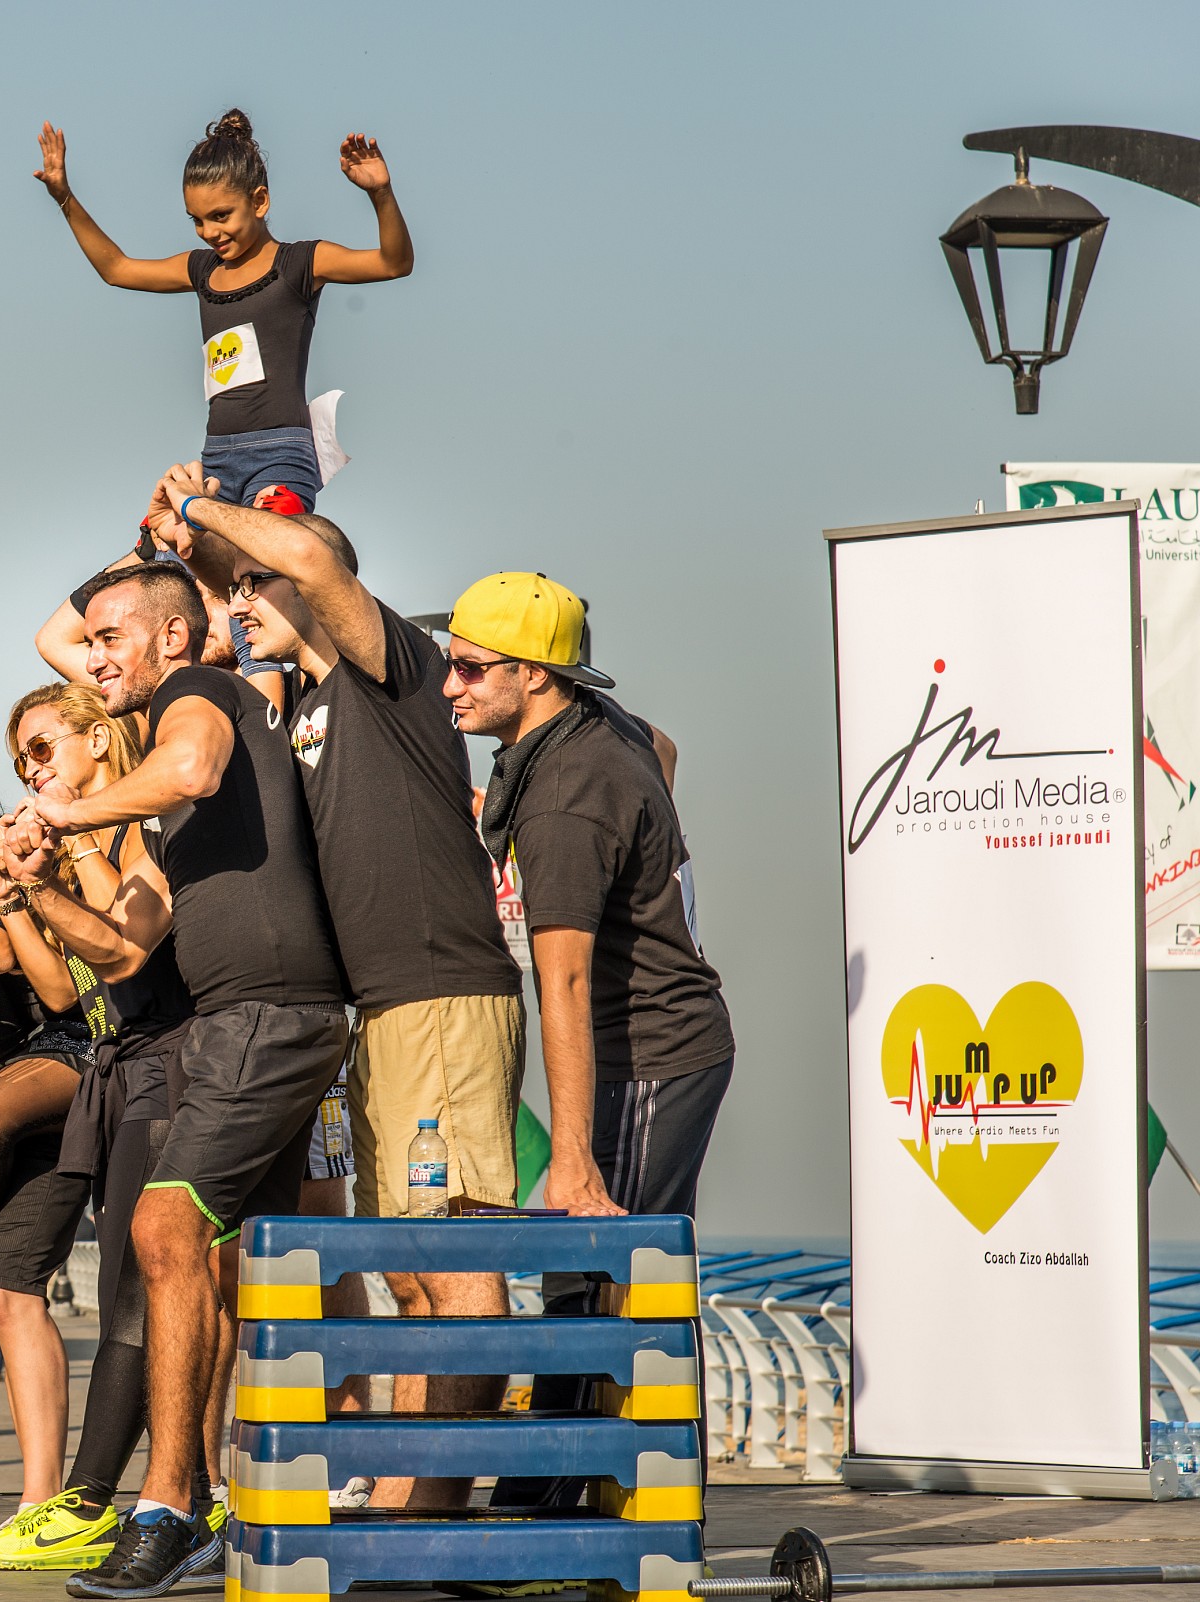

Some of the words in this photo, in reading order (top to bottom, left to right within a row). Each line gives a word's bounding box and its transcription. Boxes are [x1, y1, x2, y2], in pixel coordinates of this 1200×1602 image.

[1145, 548, 1200, 561] Universit
[895, 780, 1005, 815] Jaroudi
[896, 816, 1025, 836] production
[1040, 812, 1112, 826] house
[985, 832, 1043, 850] Youssef
[1049, 829, 1111, 848] jaroudi
[1160, 825, 1172, 849] of
[934, 1126, 963, 1136] Where
[968, 1126, 1004, 1136] Cardio
[1009, 1126, 1037, 1136] Meets
[1042, 1126, 1060, 1136] Fun
[409, 1168, 430, 1182] Rim
[984, 1251, 1016, 1265] Coach
[1019, 1252, 1042, 1265] Zizo
[1045, 1252, 1089, 1266] Abdallah
